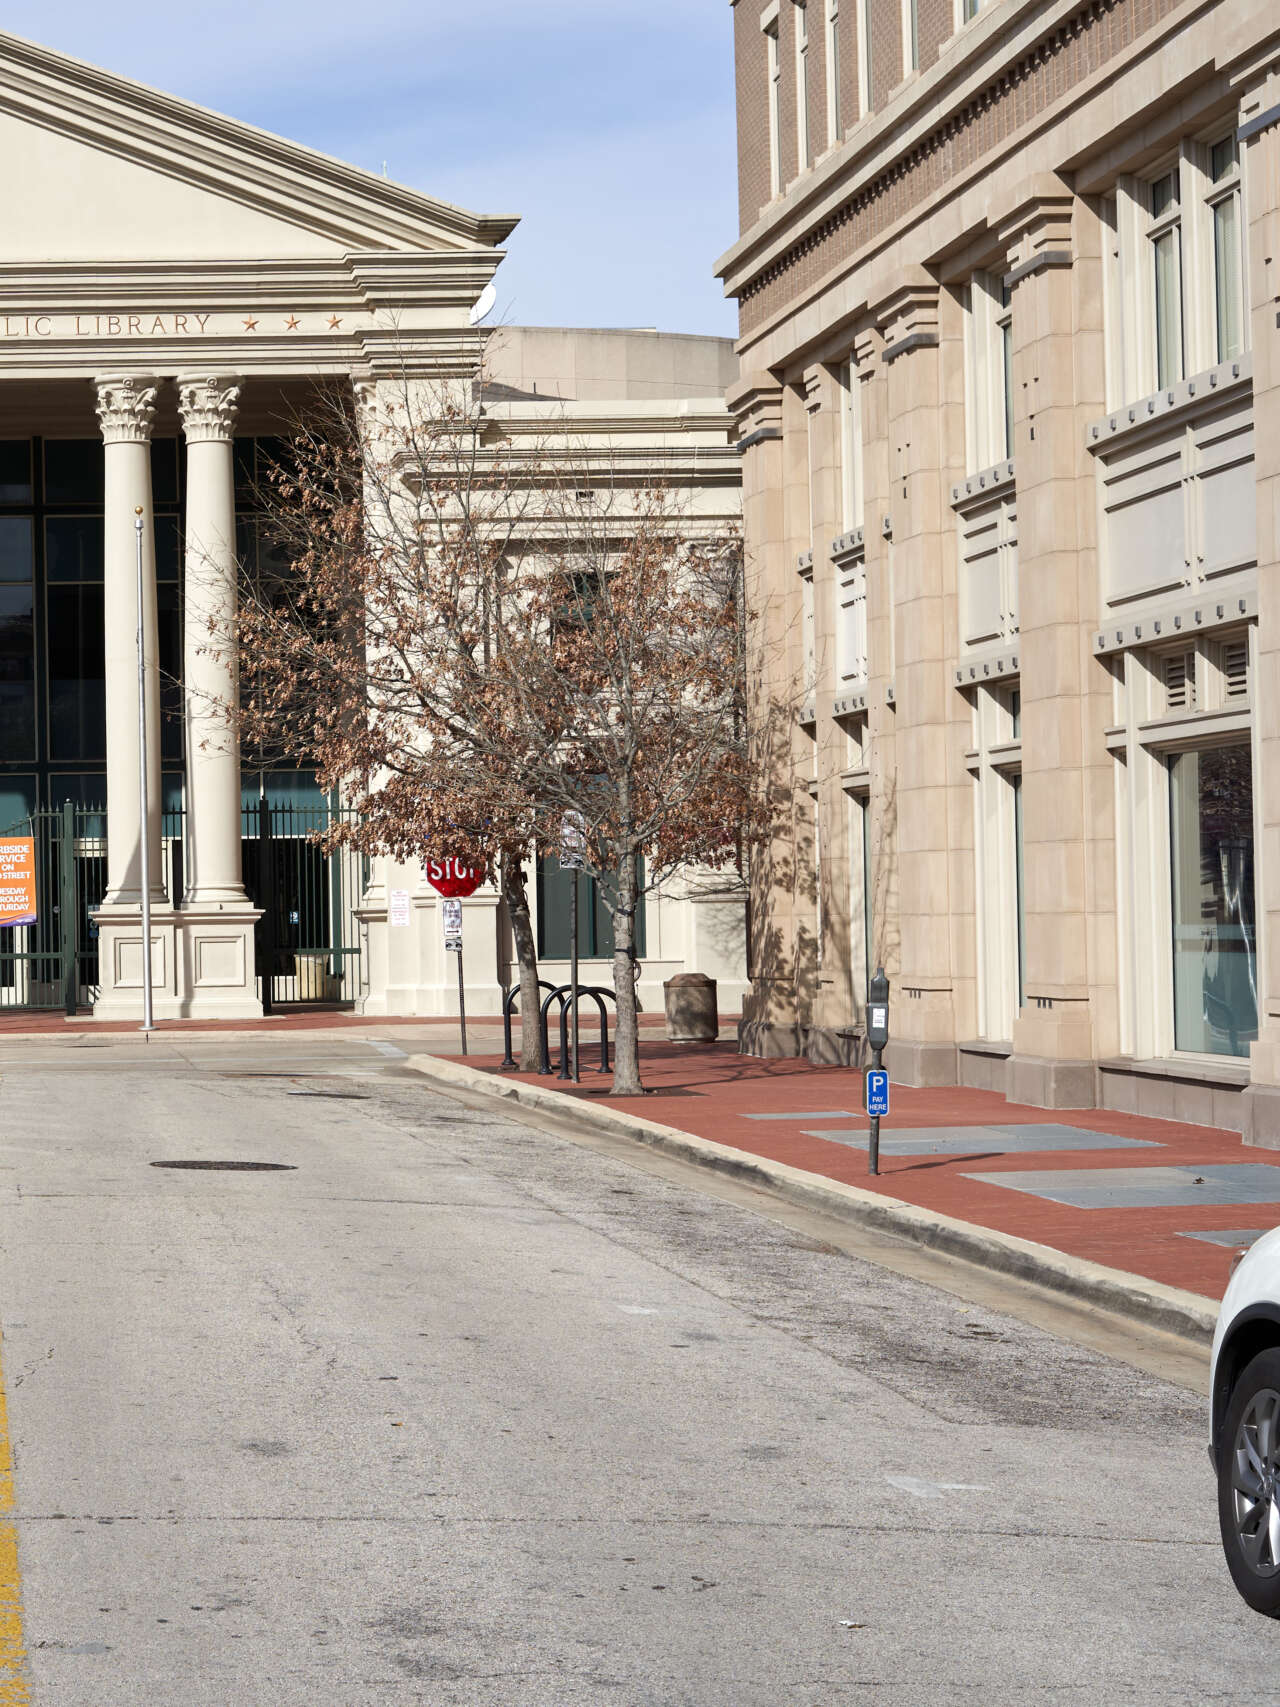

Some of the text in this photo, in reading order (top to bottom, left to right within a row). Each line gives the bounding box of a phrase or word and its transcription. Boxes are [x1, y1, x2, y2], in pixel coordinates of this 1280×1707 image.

[75, 314, 211, 336] LIBRARY
[3, 872, 31, 880] STREET
[873, 1076, 884, 1092] P
[869, 1103, 887, 1111] HERE
